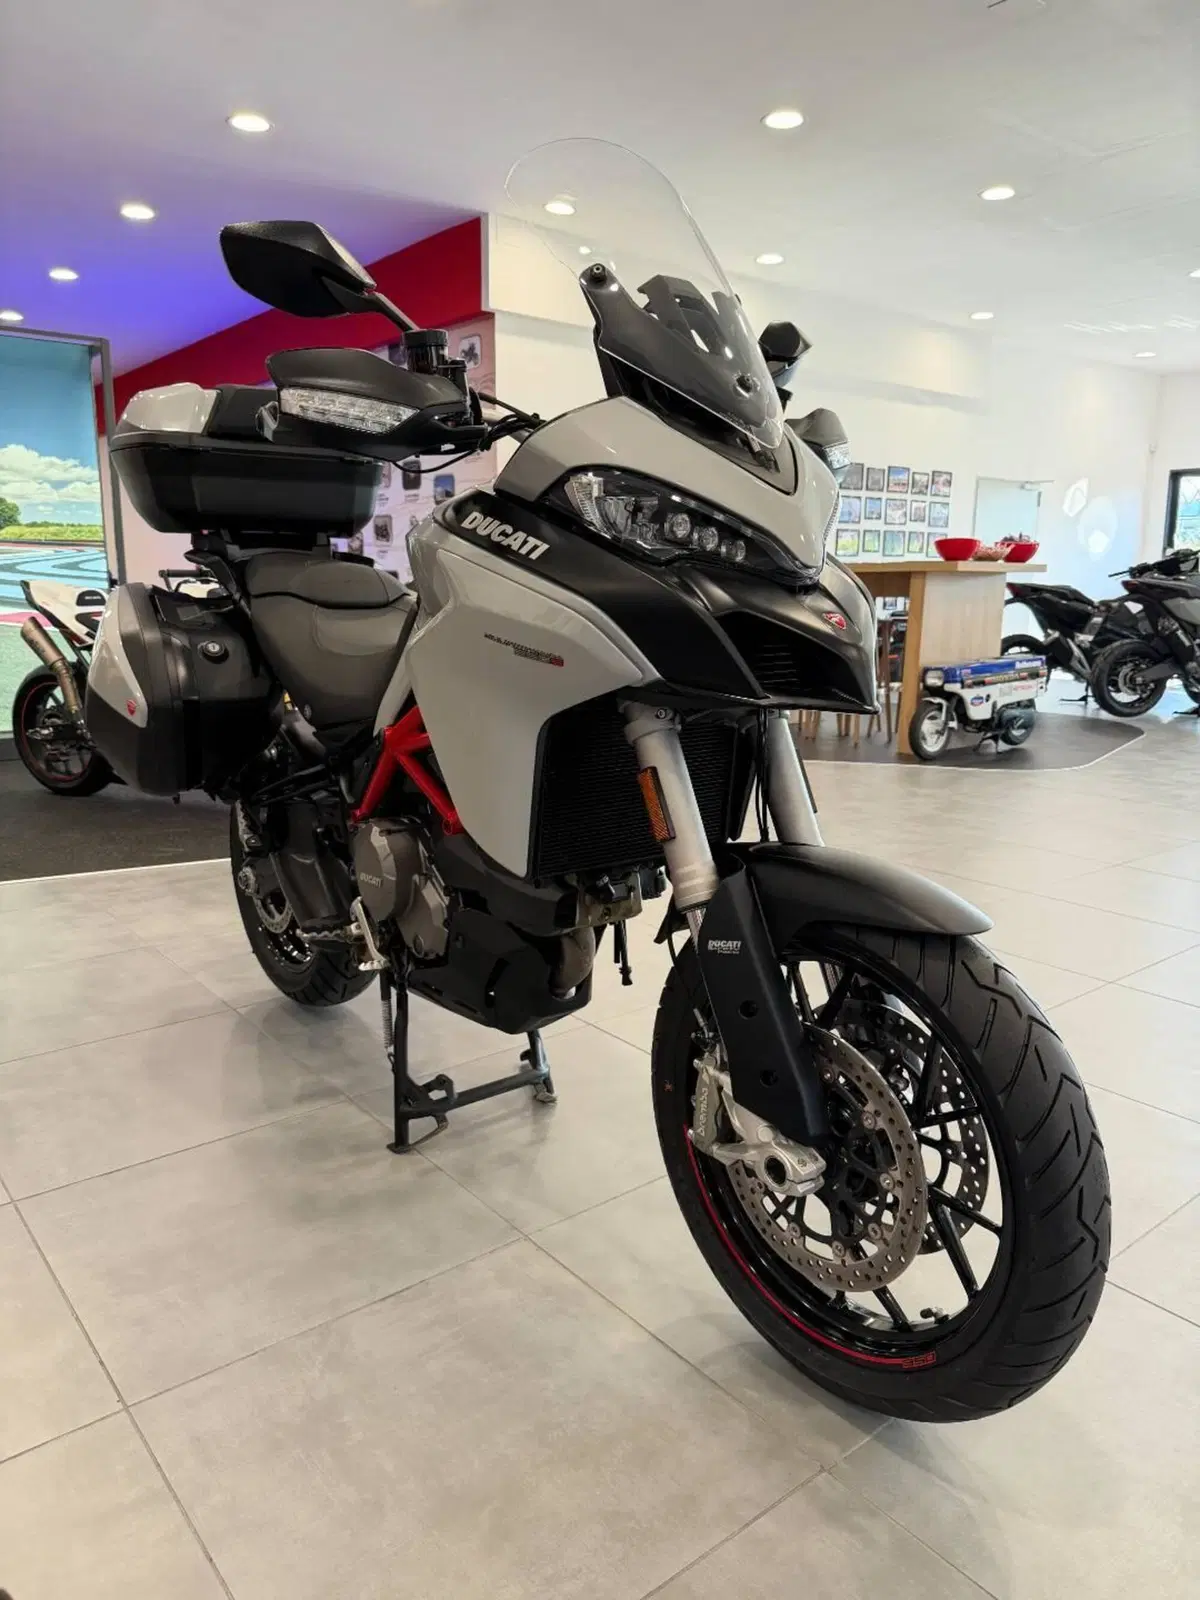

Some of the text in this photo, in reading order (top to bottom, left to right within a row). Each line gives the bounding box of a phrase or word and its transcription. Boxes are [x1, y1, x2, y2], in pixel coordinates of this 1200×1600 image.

[461, 511, 551, 561] DUCATI
[360, 872, 381, 887] DUCATI
[708, 940, 741, 950] DUCATI
